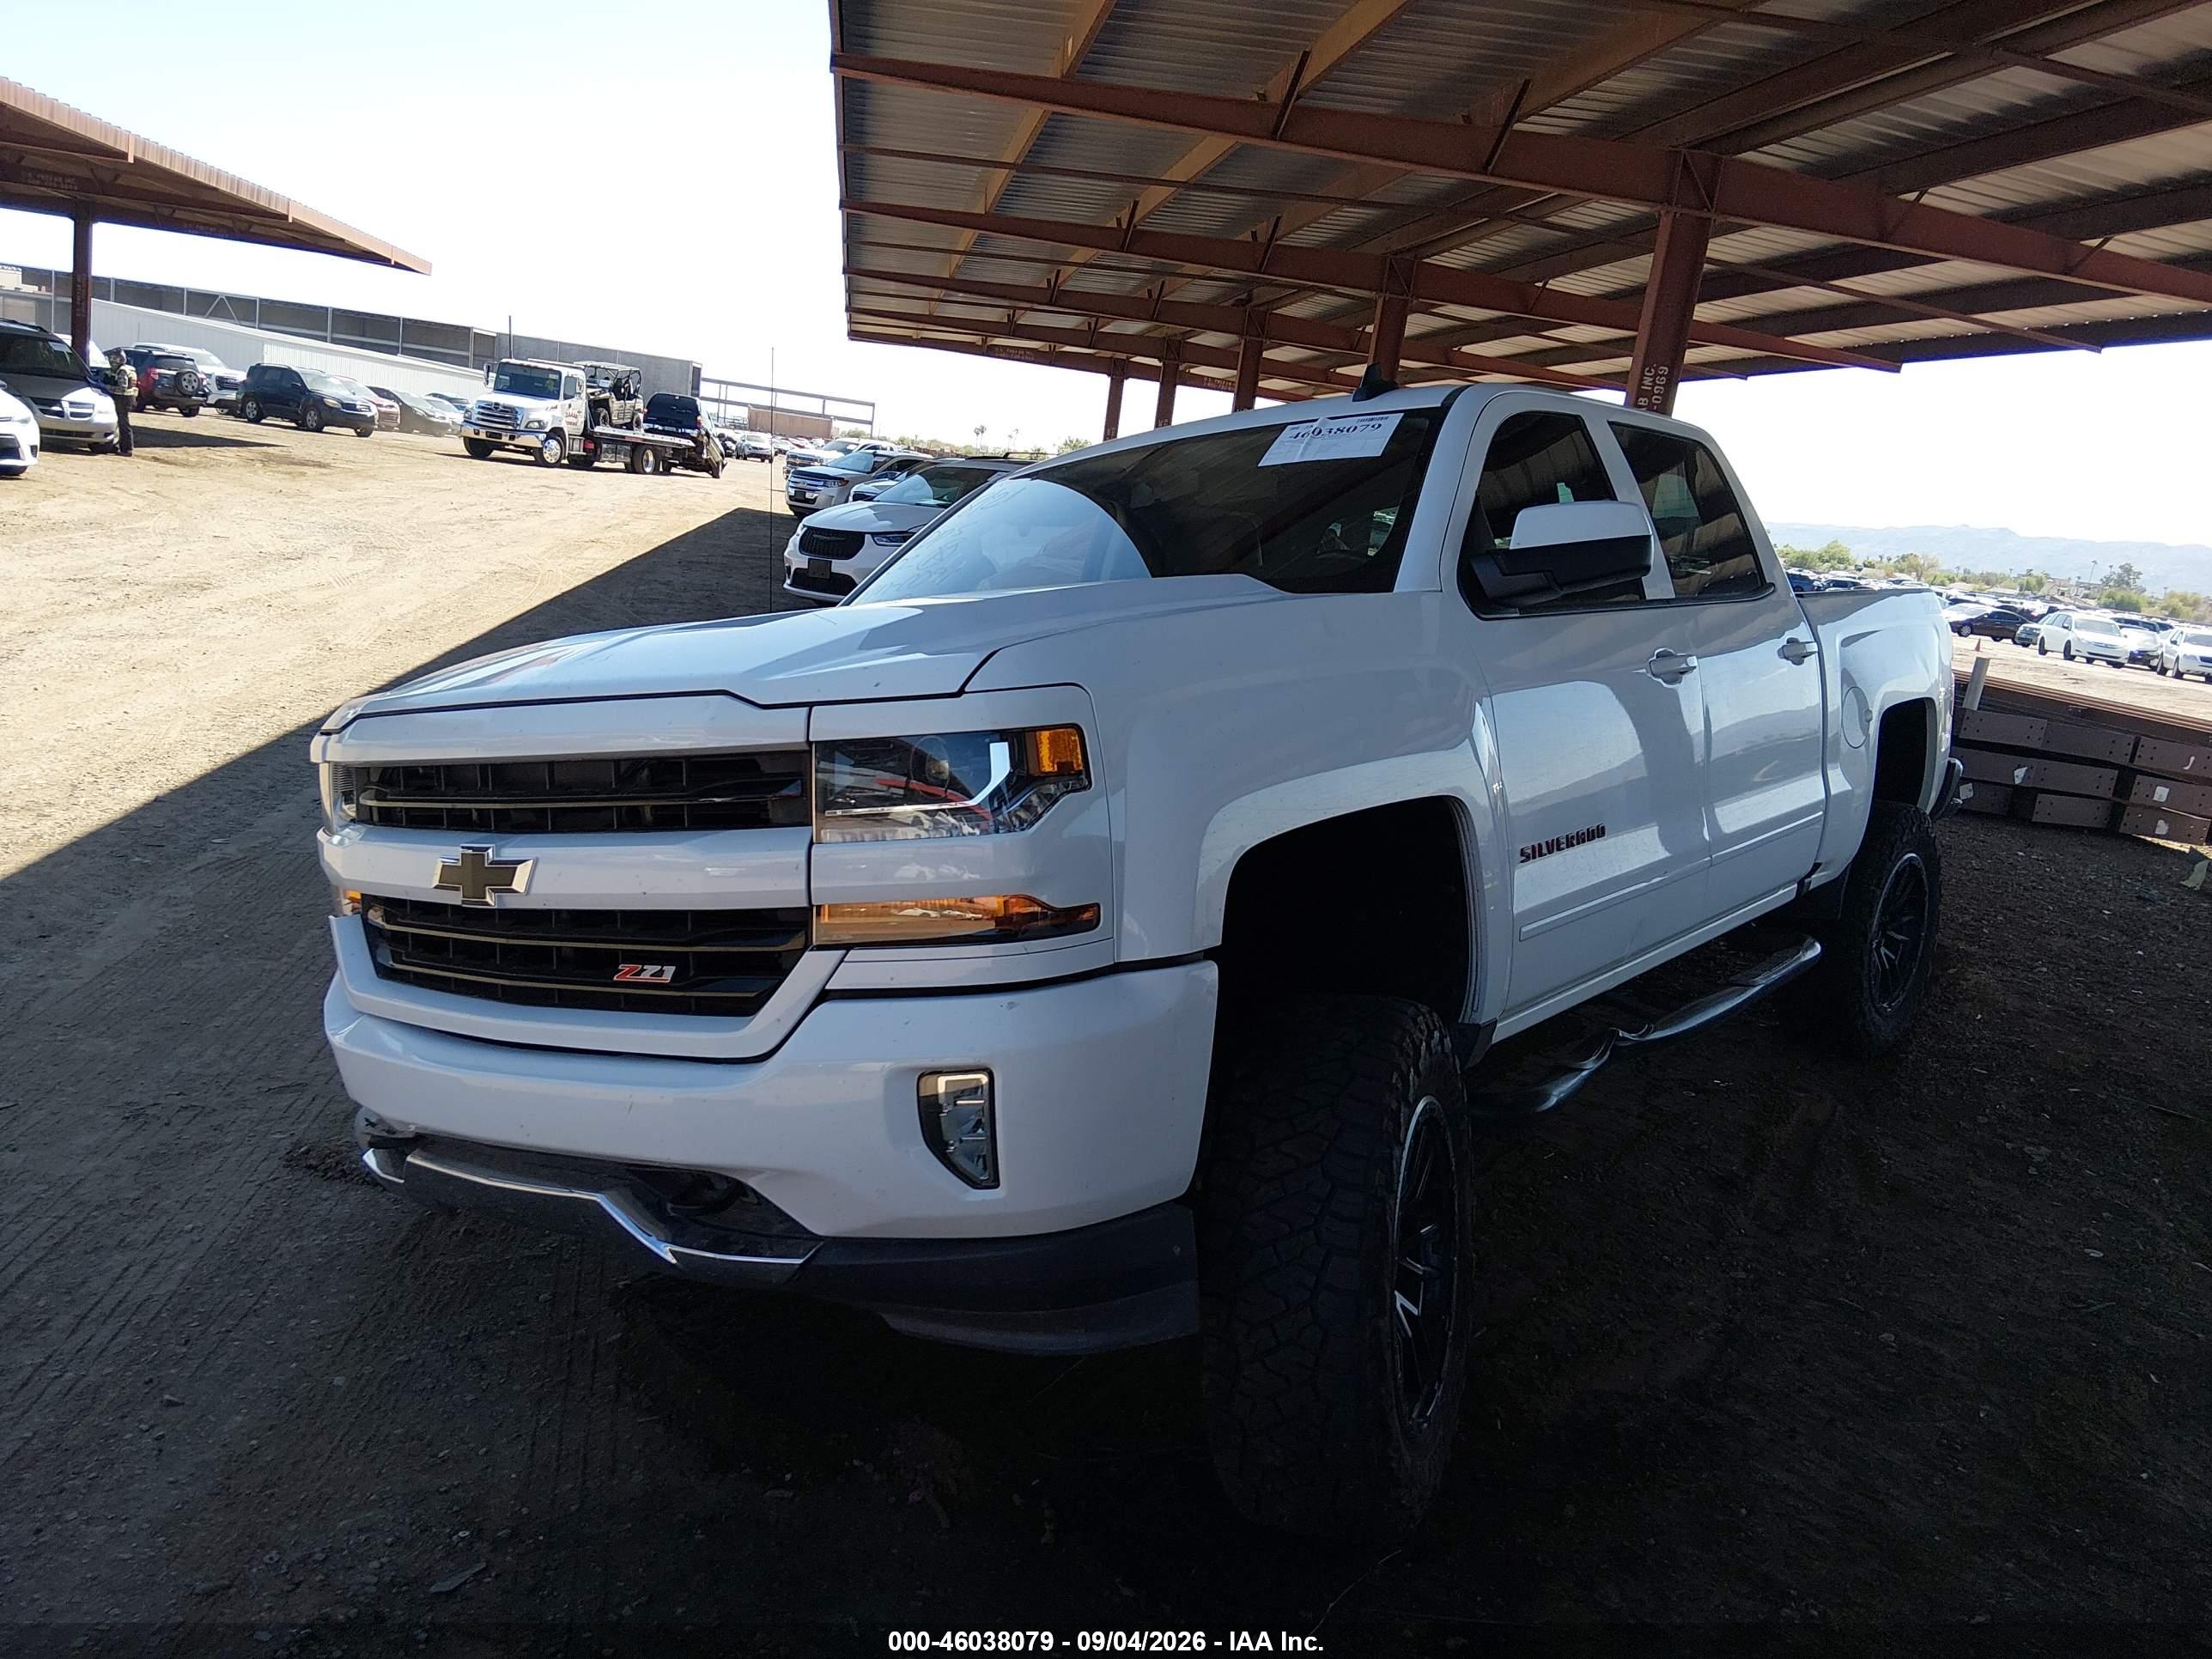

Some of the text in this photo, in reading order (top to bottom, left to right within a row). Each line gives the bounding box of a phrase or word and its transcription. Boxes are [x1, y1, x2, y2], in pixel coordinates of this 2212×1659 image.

[1640, 363, 1656, 391] INC.
[1519, 823, 1607, 864] SILVERADO
[613, 963, 676, 983] Z71
